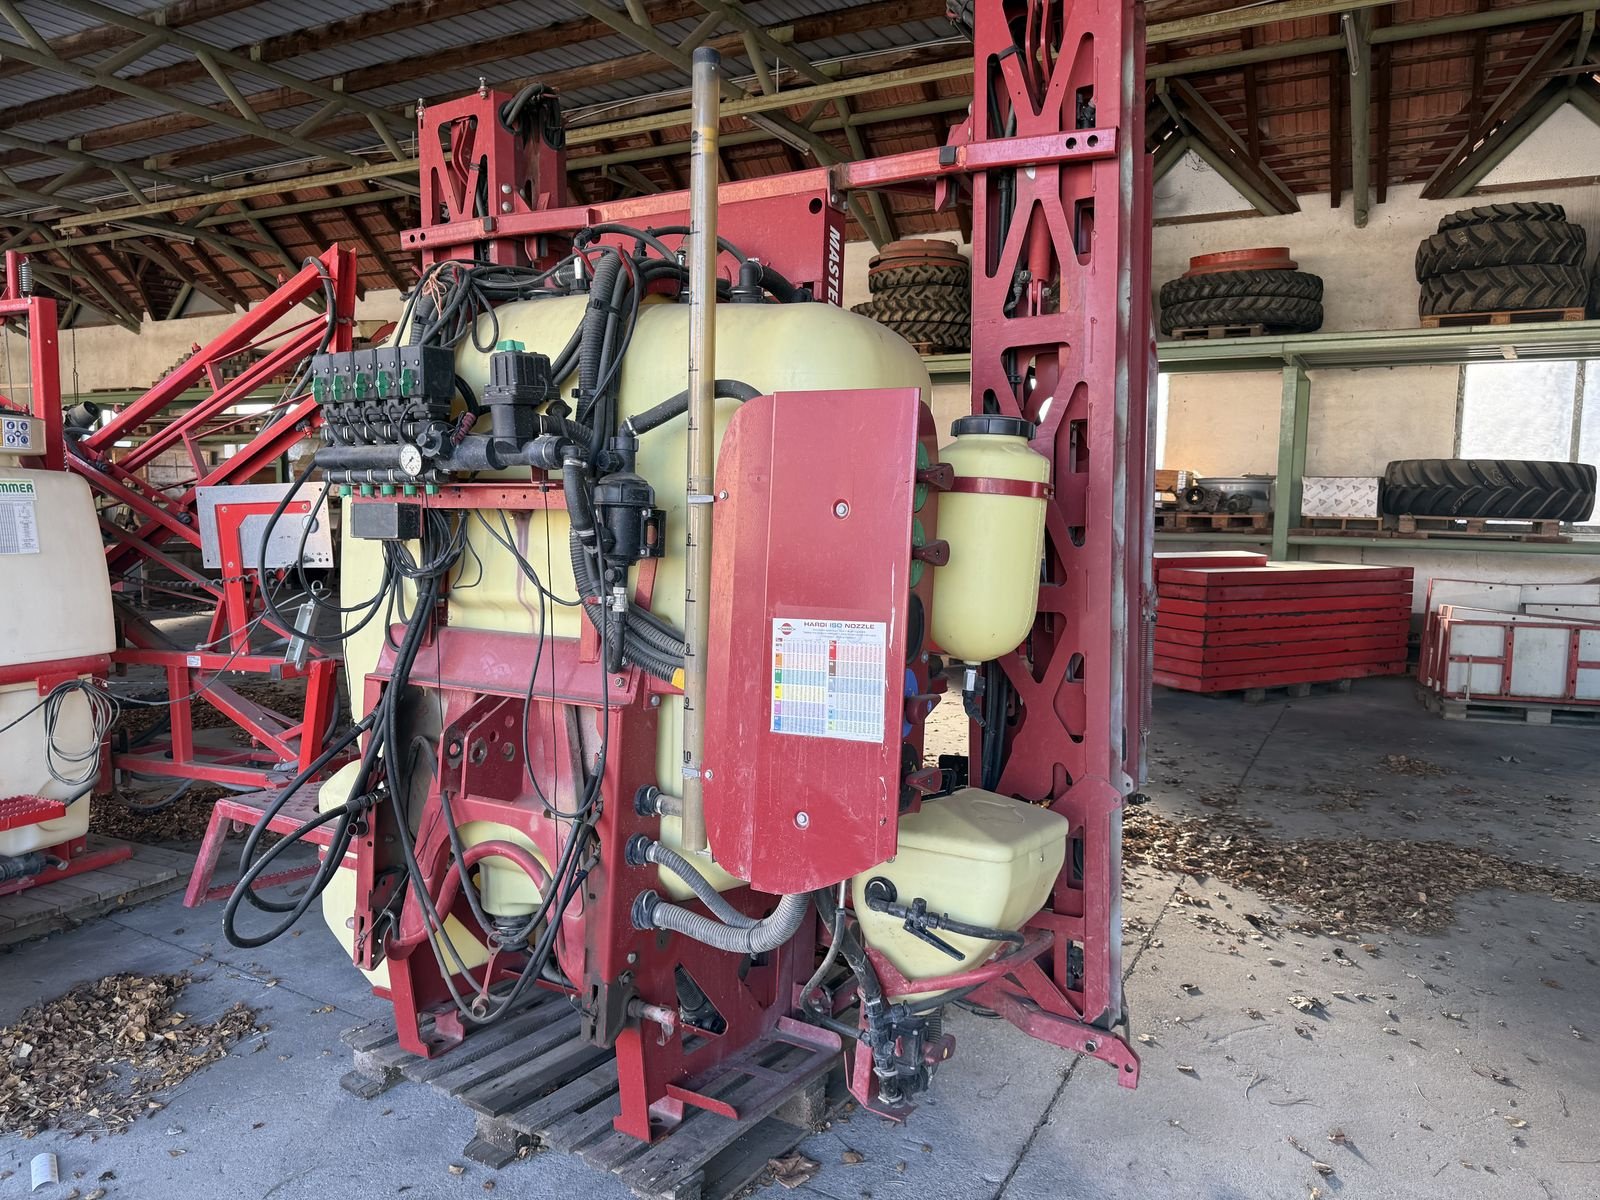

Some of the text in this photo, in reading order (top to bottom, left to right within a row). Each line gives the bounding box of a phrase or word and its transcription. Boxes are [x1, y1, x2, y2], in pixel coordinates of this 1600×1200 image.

[827, 224, 841, 308] MASTE
[803, 621, 828, 629] HARDI
[829, 622, 843, 630] ISO
[683, 749, 692, 762] 10
